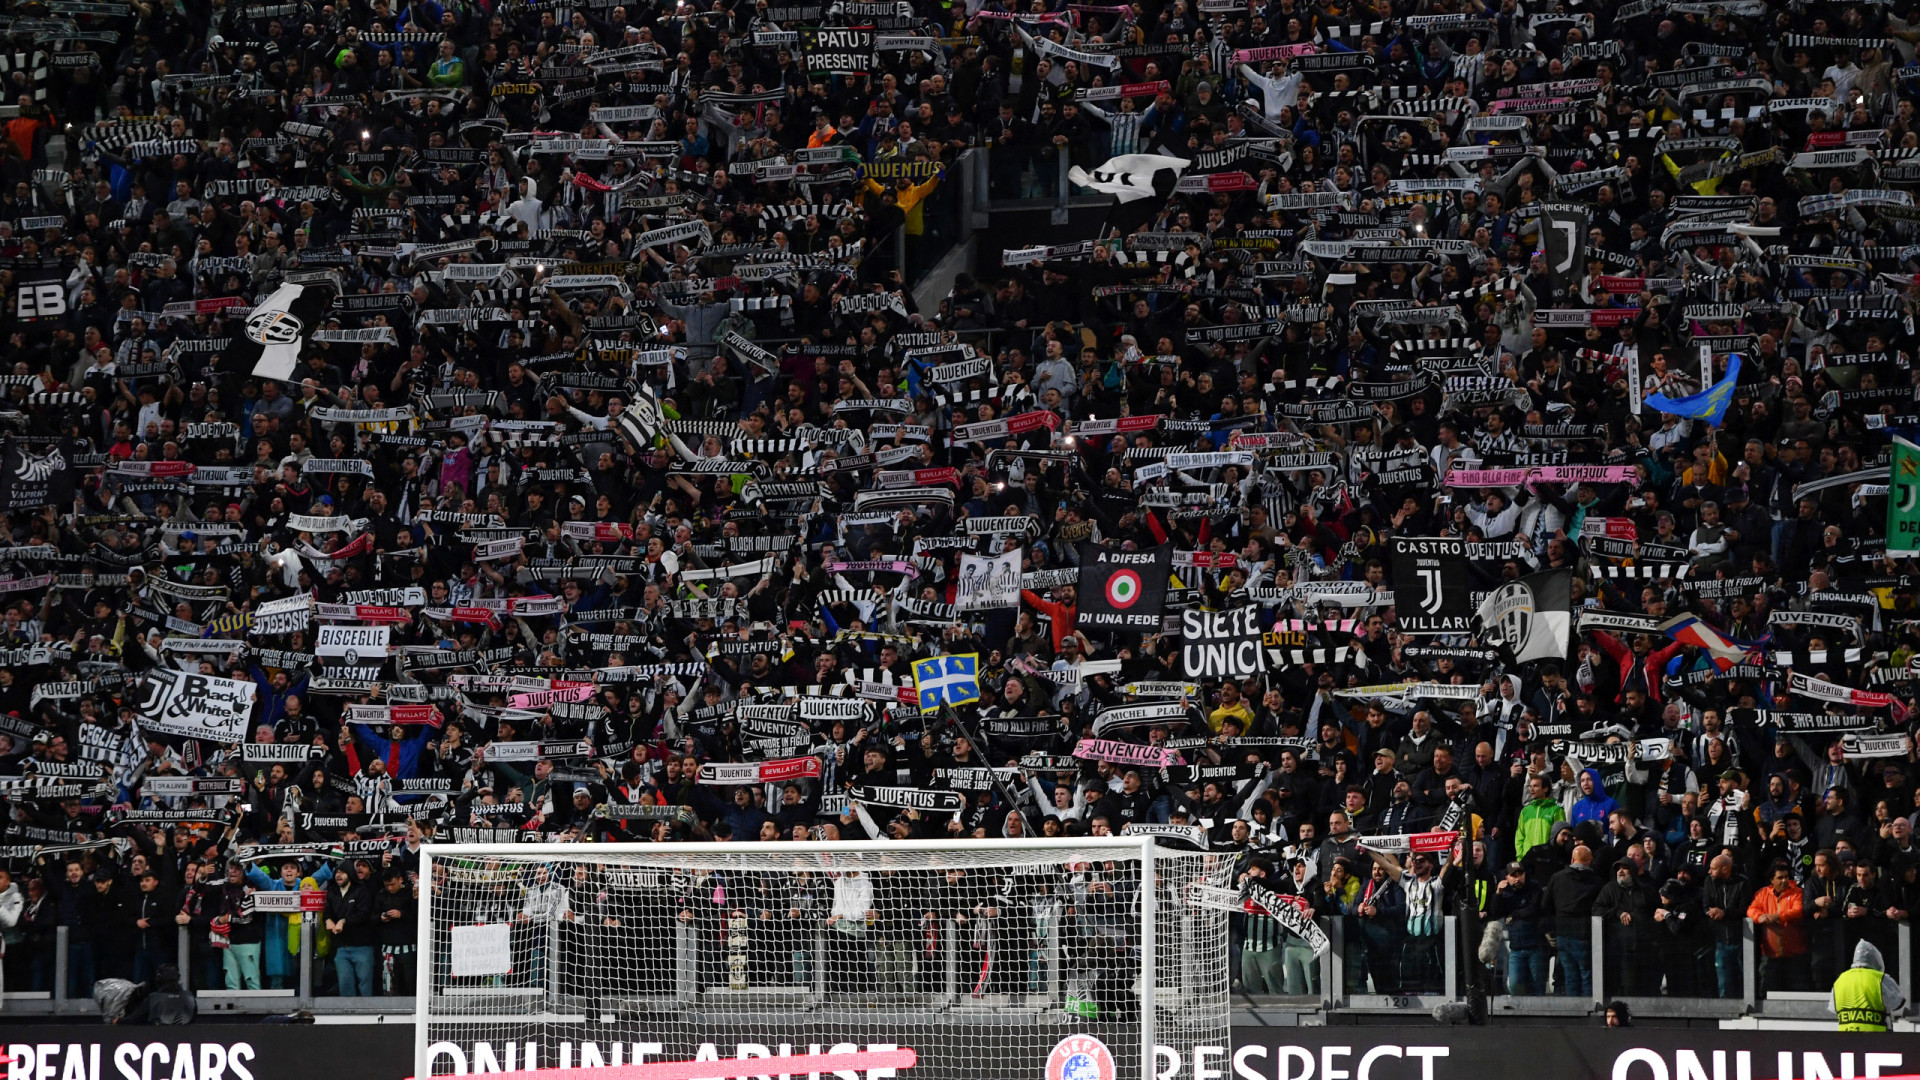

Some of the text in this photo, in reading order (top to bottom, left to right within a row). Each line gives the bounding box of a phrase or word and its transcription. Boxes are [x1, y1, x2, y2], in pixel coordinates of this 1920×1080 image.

[818, 31, 859, 48] PATU
[1248, 48, 1292, 60] JUVENTUS
[807, 54, 868, 72] PRESENTE
[1304, 55, 1359, 68] FINO ALLA FINE
[1772, 98, 1828, 108] JUVENTUS
[1814, 152, 1856, 164] JUVENTUS
[862, 162, 940, 178] JUVENTUS
[1362, 249, 1420, 260] FINO ALLA FINE
[1608, 252, 1636, 267] ODIO
[17, 284, 66, 318] EB
[1552, 313, 1584, 322] JUVENTUS
[1848, 310, 1899, 318] TREIA
[1833, 352, 1888, 365] TREIA
[936, 361, 987, 380] JUVENTUS
[1844, 388, 1911, 400] JUVENTUS
[1083, 421, 1111, 430] JUVENTUS
[1122, 419, 1142, 427] SEVILLA
[1524, 424, 1586, 436] FINO ALLA FINE
[1275, 452, 1331, 466] FORZA JUVE
[1515, 452, 1567, 465] MELFI
[308, 459, 362, 472] BIANCONERI
[692, 461, 750, 472] JUVENTUS
[1379, 468, 1422, 484] JUVENTUS
[1462, 471, 1522, 483] FINO ALLA FINE
[11, 491, 48, 499] VAPRIO
[9, 499, 44, 508] D'ADDA
[970, 517, 1024, 531] JUVENTUS
[492, 543, 518, 553] JUVENTUS
[730, 535, 796, 551] BLACK AND WHITE
[1397, 542, 1460, 554] CASTRO
[1098, 553, 1156, 564] A DIFESA
[1683, 576, 1764, 590] DI PADRE IN FIGLIO
[346, 589, 404, 606] JUVENTUS
[1699, 587, 1744, 598] SINCE 1897
[322, 606, 350, 614] JUVENTUS
[980, 600, 1008, 608] MAGLIA
[578, 609, 624, 620] JUVENTUS
[1079, 613, 1160, 625] DI UNA FEDE
[1771, 612, 1855, 627] JUVENTUS
[1183, 604, 1260, 639] SIETE
[1400, 617, 1471, 629] VILLARI
[1603, 616, 1640, 628] FORZA
[322, 629, 383, 646] BISCEGLIE
[590, 634, 613, 643] PADRE
[623, 634, 647, 644] FIGLIO
[592, 642, 630, 651] SINCE 1897
[722, 642, 778, 653] JUVENTUS
[417, 651, 476, 666] FINO ALLA FINE
[1184, 640, 1266, 677] UNICI
[1420, 648, 1484, 659] #FinoAllaFine
[40, 683, 80, 695] FORZA
[182, 674, 239, 703] Black
[214, 679, 234, 688] BAR
[527, 688, 580, 708] JUVENTUS
[167, 694, 231, 717] & White
[804, 702, 860, 717] JUVENTUS
[890, 707, 918, 718] FORZA
[1110, 709, 1147, 720] MICHEL
[188, 726, 243, 739] CASTELLUZZO
[750, 722, 797, 735] JUVENTUS
[1538, 724, 1572, 735] JUVENTUS
[78, 723, 122, 749] CEGLIE
[758, 739, 779, 749] PADRE
[781, 738, 789, 747] IN
[790, 736, 810, 746] FIGLIO
[1864, 740, 1900, 750] JUVENTUS
[764, 747, 796, 758] SINCE 1897
[1089, 741, 1162, 760] JUVENTUS
[719, 764, 800, 778] JUVENTUS SEVILLA FC
[936, 769, 946, 778] DI
[947, 769, 972, 780] PADRE
[976, 770, 984, 780] IN
[1202, 766, 1236, 778] JUVENTUS
[402, 778, 451, 790] JUVENTUS
[950, 779, 993, 790] SINCE 1897
[873, 787, 936, 807] JUVENTUS
[126, 811, 163, 819] JUVENTUS
[186, 809, 216, 818] VARESE
[610, 805, 676, 816] FORZA JUVE
[453, 828, 518, 843] BLACK AND WHITE
[349, 841, 390, 851] TI ODIO
[259, 896, 293, 906] JUVENTUS
[1384, 997, 1409, 1008] 120
[1059, 1038, 1100, 1059] UEFA
[8, 1042, 256, 1080] REAL SCARS
[1152, 1045, 1450, 1080] RESPECT
